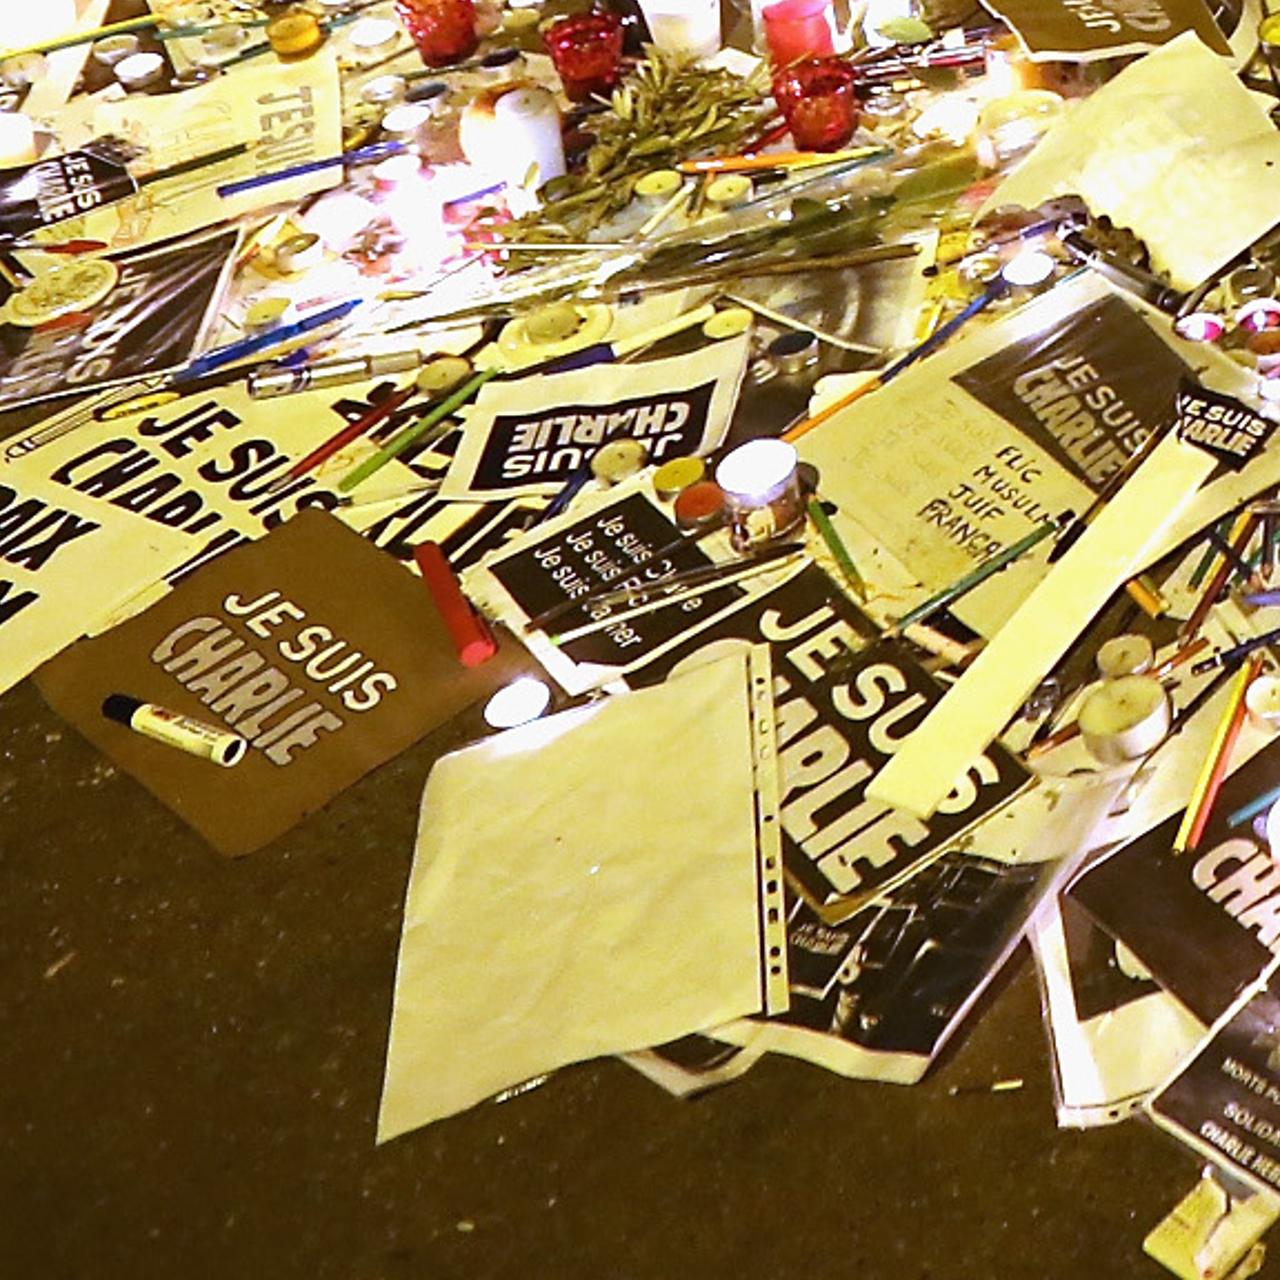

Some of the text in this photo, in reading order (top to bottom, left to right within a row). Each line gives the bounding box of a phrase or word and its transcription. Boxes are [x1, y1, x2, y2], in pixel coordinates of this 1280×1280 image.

[508, 402, 690, 453] CHARLIE
[1012, 367, 1125, 484] CHARLIE
[1050, 354, 1151, 454] JE SUIS
[1204, 404, 1267, 437] SUIS
[138, 401, 242, 460] JE
[502, 446, 594, 479] UIS
[566, 531, 623, 581] Je suis
[598, 514, 653, 565] Je suis
[534, 547, 591, 599] Je suis
[223, 591, 398, 712] JE SUIS
[150, 616, 344, 766] CHARLIE
[758, 606, 999, 815] JE SUS
[1221, 1057, 1267, 1095] MORTS
[1200, 1121, 1254, 1167] CHARLIE
